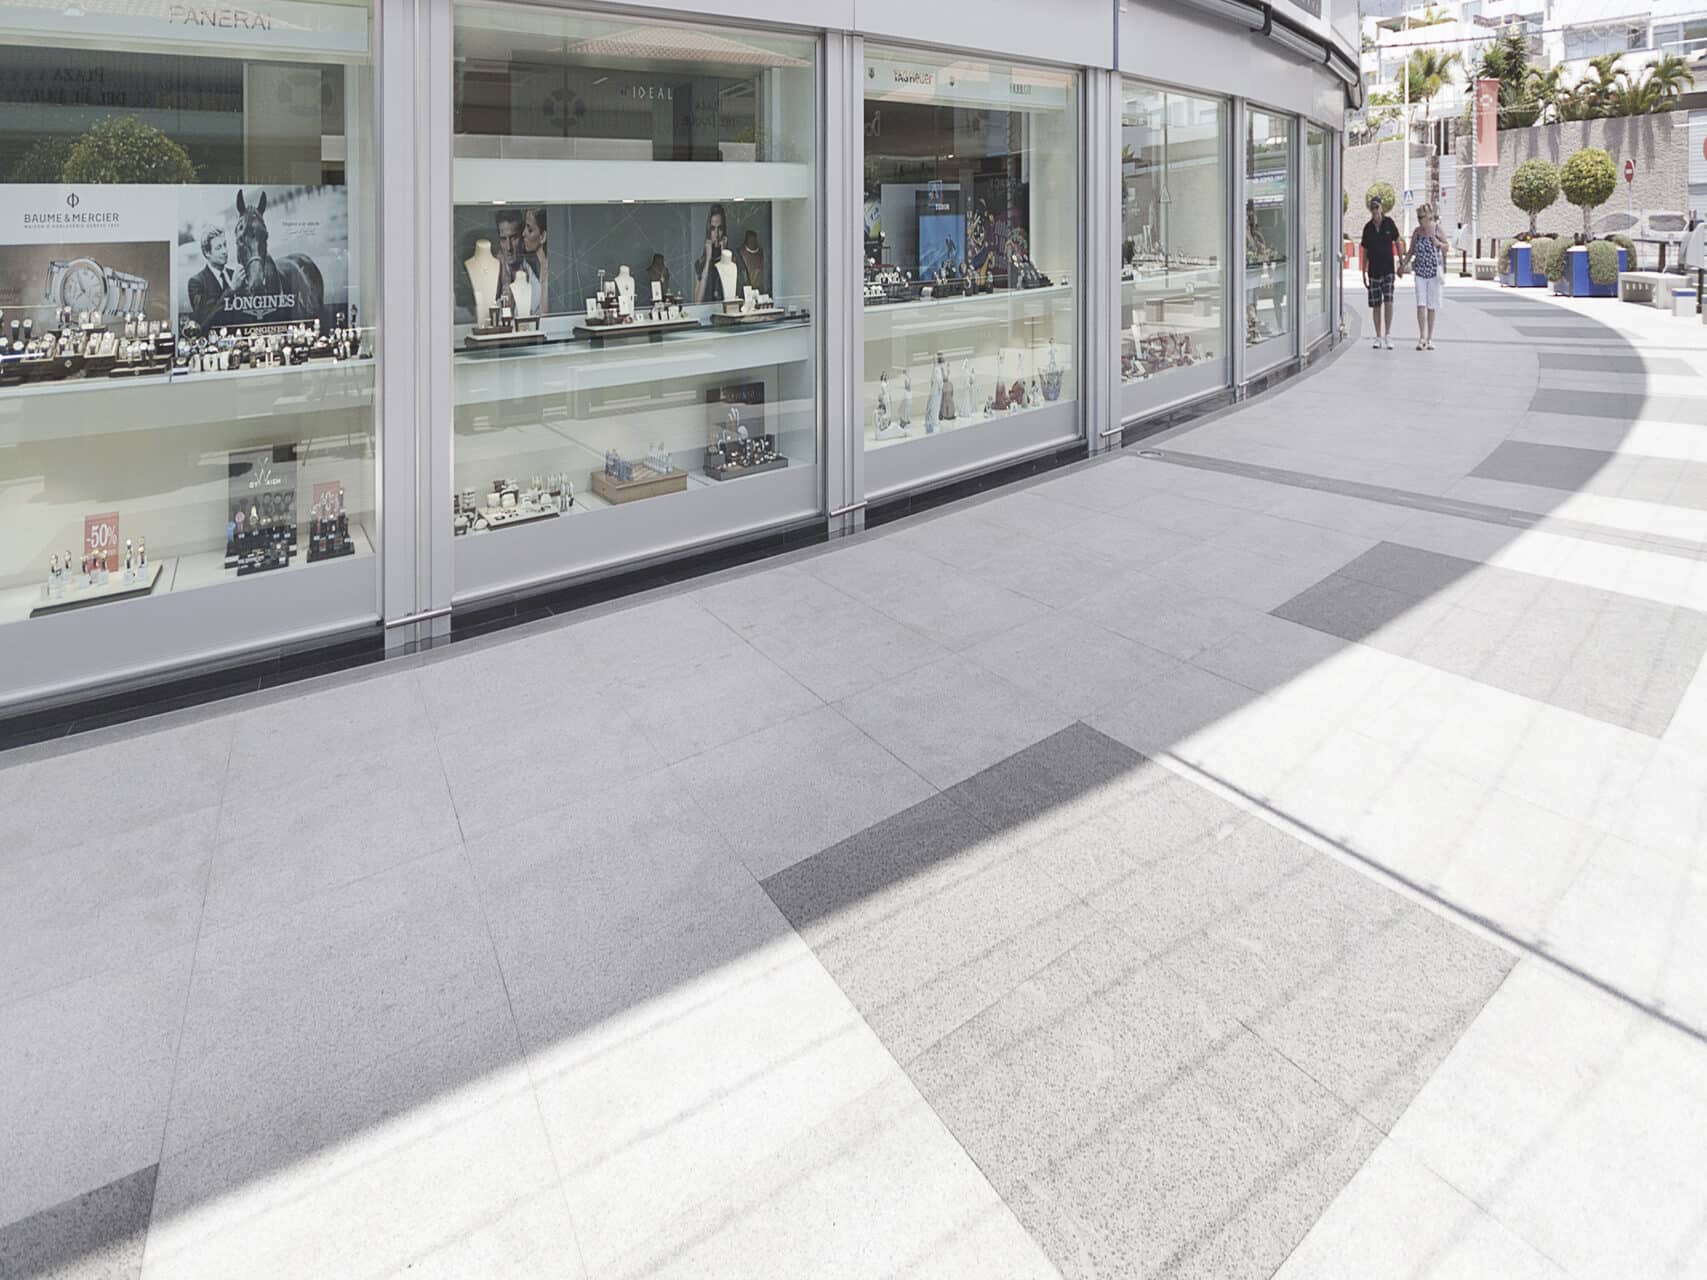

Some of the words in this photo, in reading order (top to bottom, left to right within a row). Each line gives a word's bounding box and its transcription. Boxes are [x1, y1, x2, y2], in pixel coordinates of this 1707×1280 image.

[169, 5, 271, 31] PANERAI
[633, 86, 672, 100] IDEAL
[223, 294, 295, 311] LONGINES
